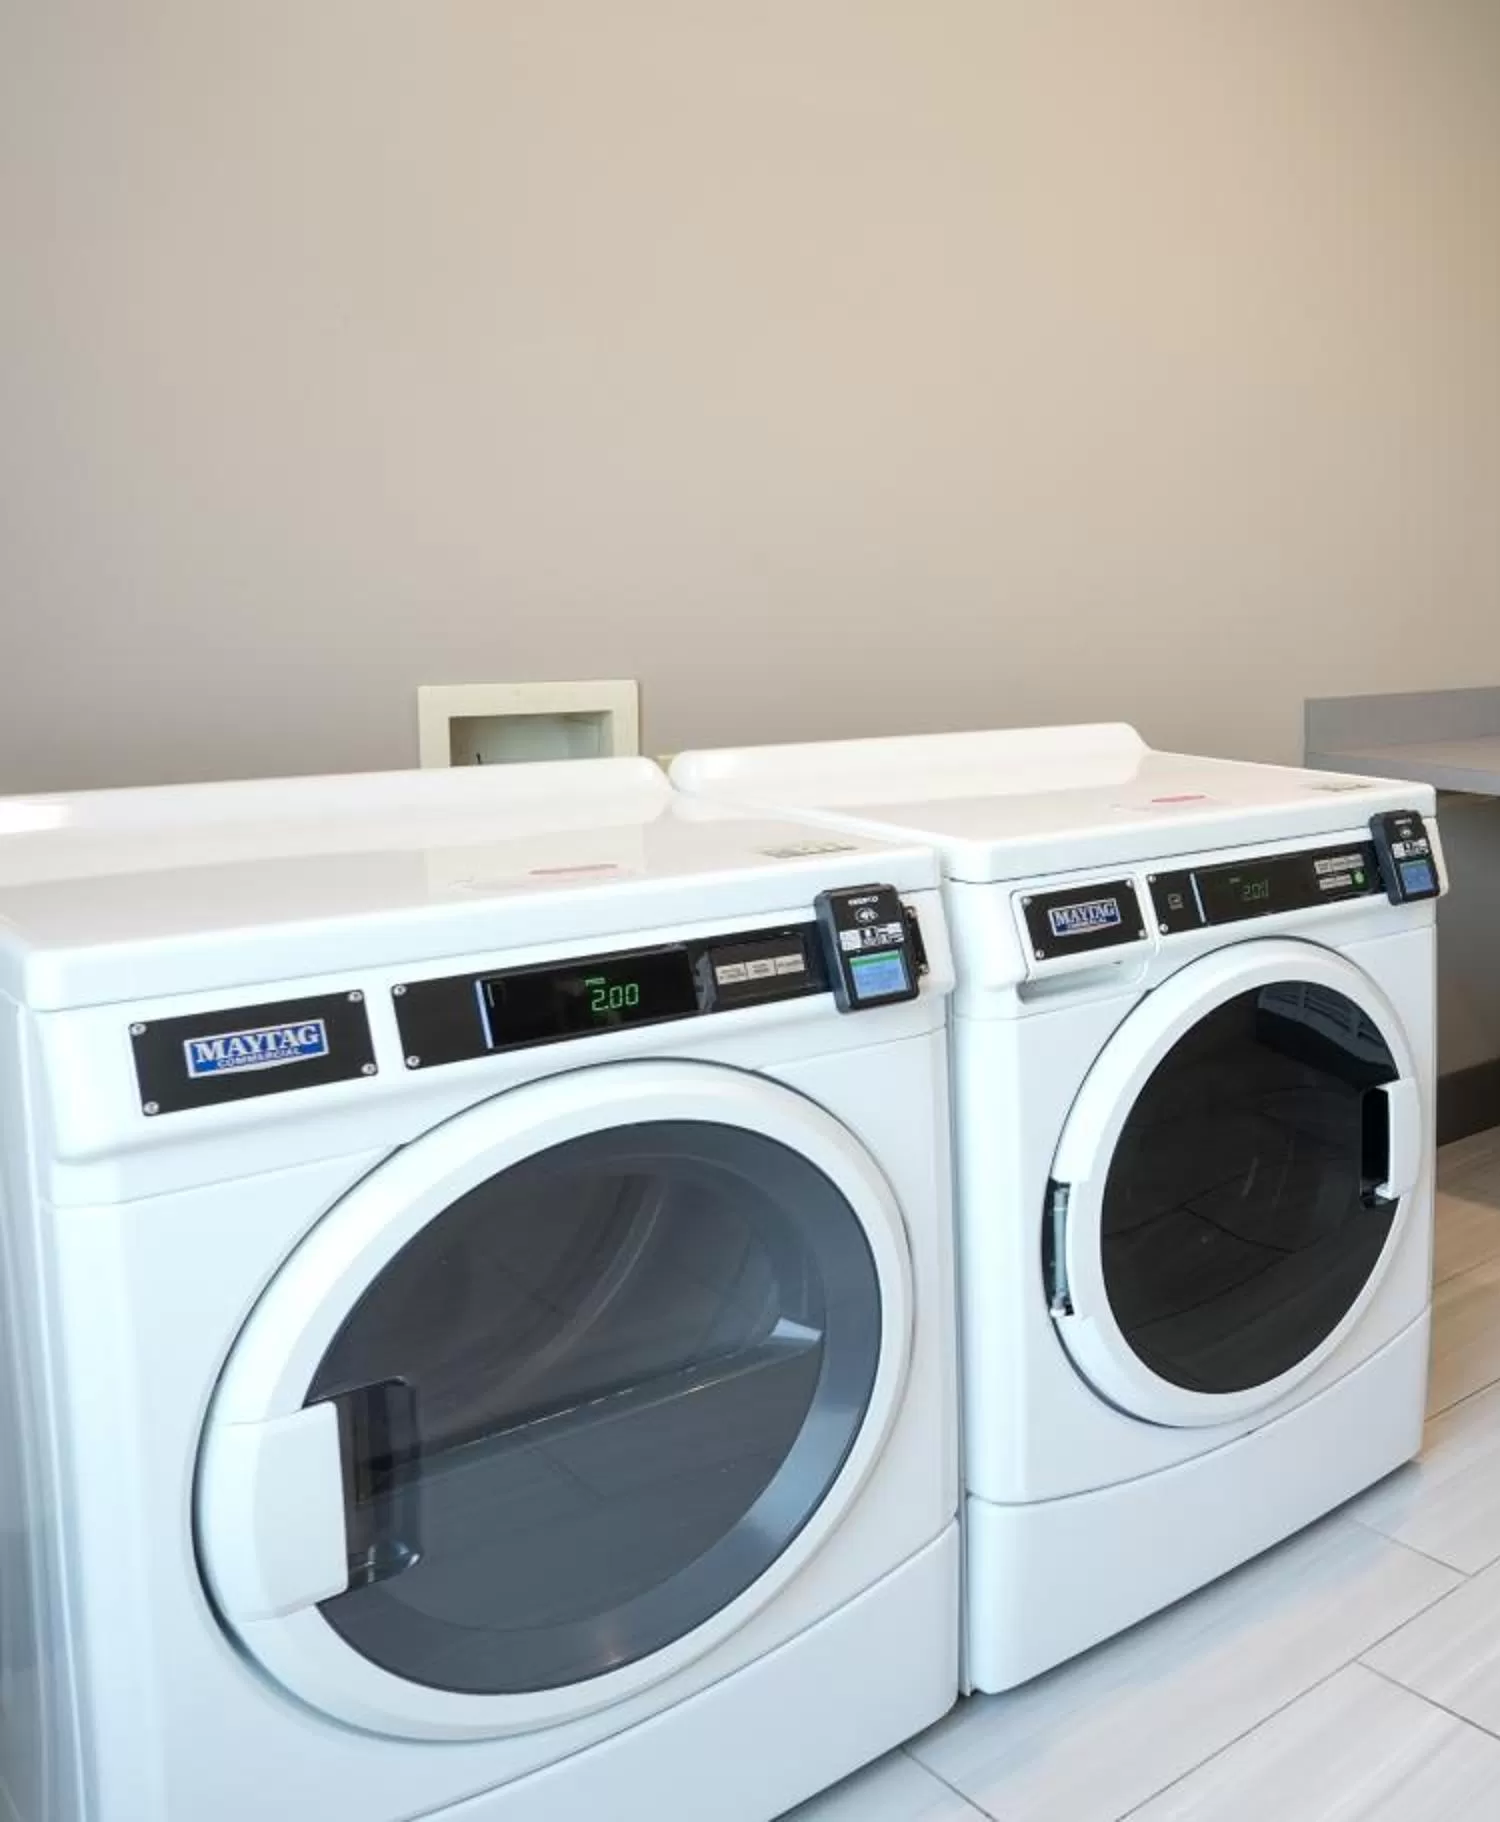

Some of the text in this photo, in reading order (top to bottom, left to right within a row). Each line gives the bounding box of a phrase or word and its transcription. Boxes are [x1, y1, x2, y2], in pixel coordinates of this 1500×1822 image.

[1055, 902, 1117, 926] MAYTAG
[591, 983, 640, 1012] 2.00
[194, 1025, 320, 1062] MAYTAG
